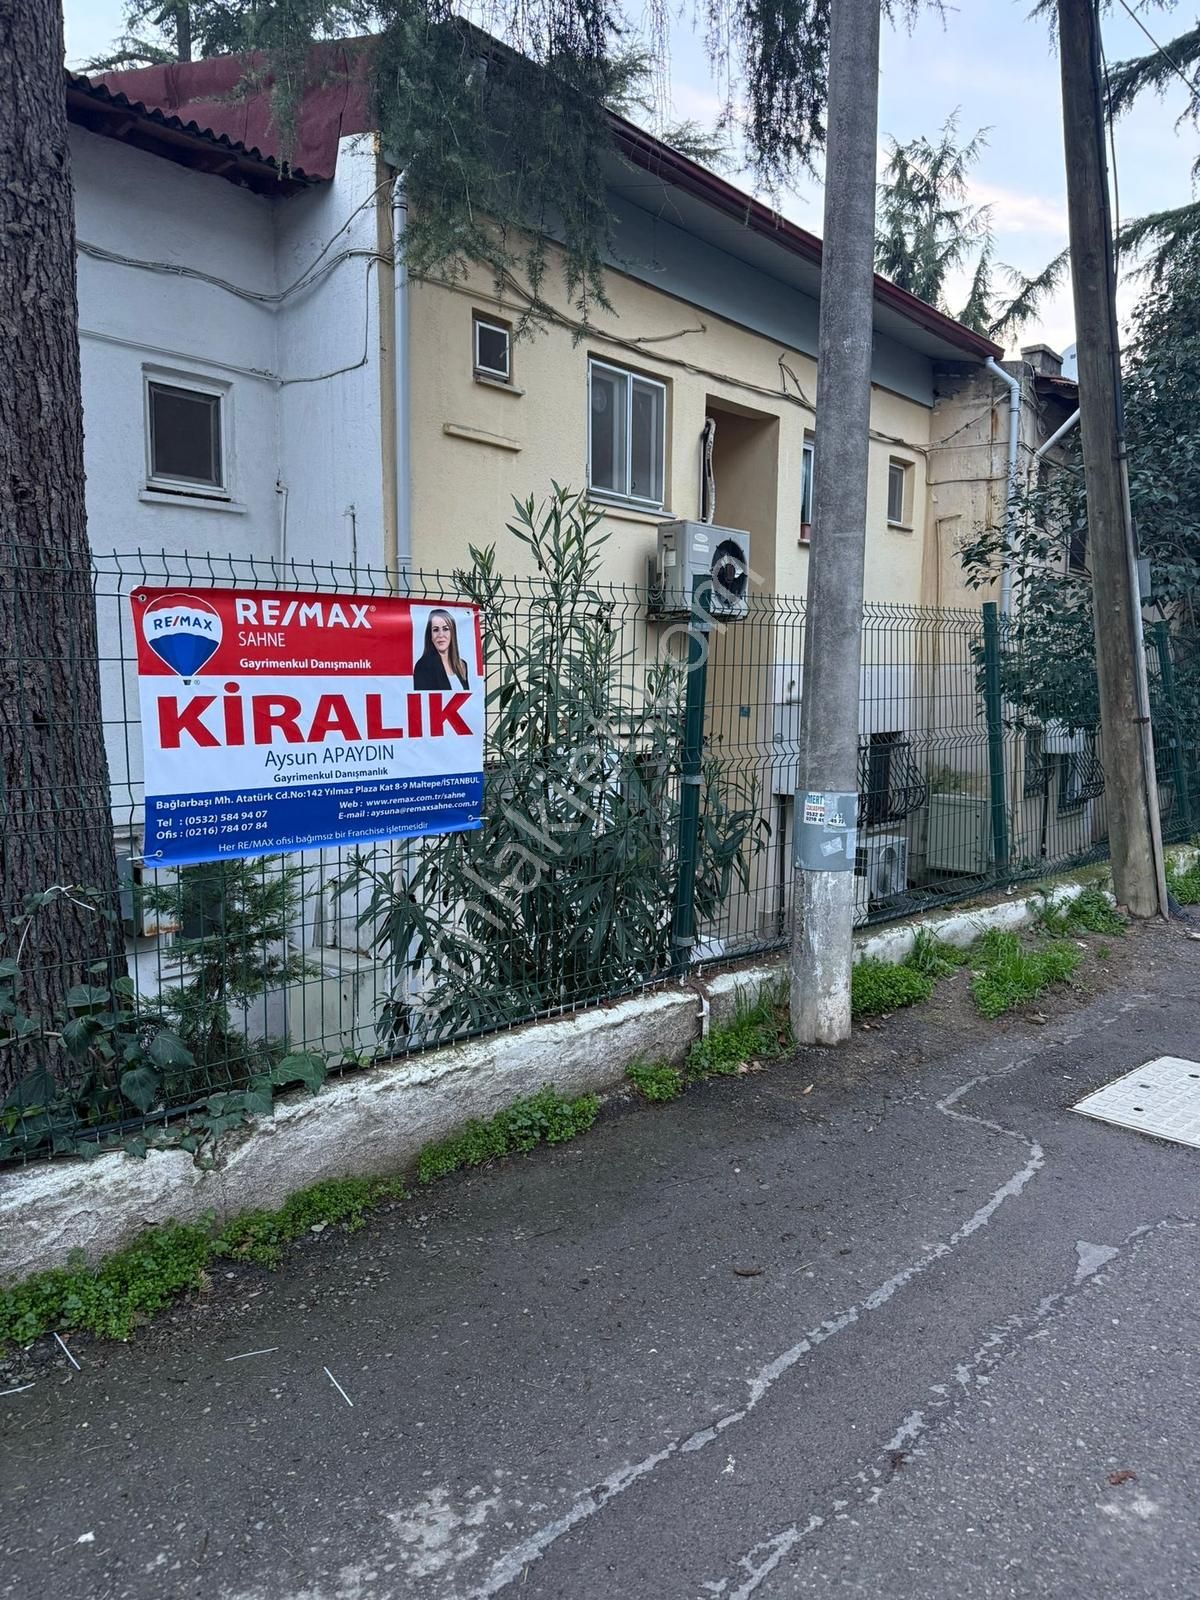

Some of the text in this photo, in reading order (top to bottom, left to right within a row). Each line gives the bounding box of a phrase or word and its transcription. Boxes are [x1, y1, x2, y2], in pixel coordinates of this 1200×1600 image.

[153, 614, 213, 633] RE/MAX
[235, 598, 372, 630] RE/MAX
[238, 631, 286, 647] SAHNE
[238, 658, 372, 671] Gayrimenkul Danışmanlık
[157, 681, 474, 749] KİRALIK
[264, 745, 394, 769] Aysun APAYDIN
[273, 768, 389, 783] Gayrimenkul Danışmanlık
[156, 798, 211, 810] Bağlarbaşı
[214, 796, 233, 805] Mh.
[236, 793, 272, 803] Atatürk
[325, 786, 353, 796] Yılmaz
[356, 784, 378, 793] Plaza
[379, 782, 393, 791] Kat
[395, 781, 408, 790] 8-9
[409, 776, 480, 789] Maltepe/İSTANBUL
[339, 800, 359, 809] Web
[366, 792, 466, 806] www.remax.com.tr/sahne
[156, 818, 172, 827] Tel
[185, 815, 218, 826] (0532)
[220, 812, 239, 821] 584
[241, 811, 254, 820] 94
[255, 810, 268, 818] 07
[338, 810, 365, 820] E-mail
[370, 801, 479, 816] aysuna@remaxsahne.com.tr
[156, 831, 178, 840] Ofis
[185, 827, 218, 838] (0216)
[220, 824, 239, 833] 784
[241, 822, 254, 831] 07
[255, 821, 268, 830] 84
[218, 822, 428, 852] Her RE/MAX ofisi bağımsız bir Franchise işletmesidir
